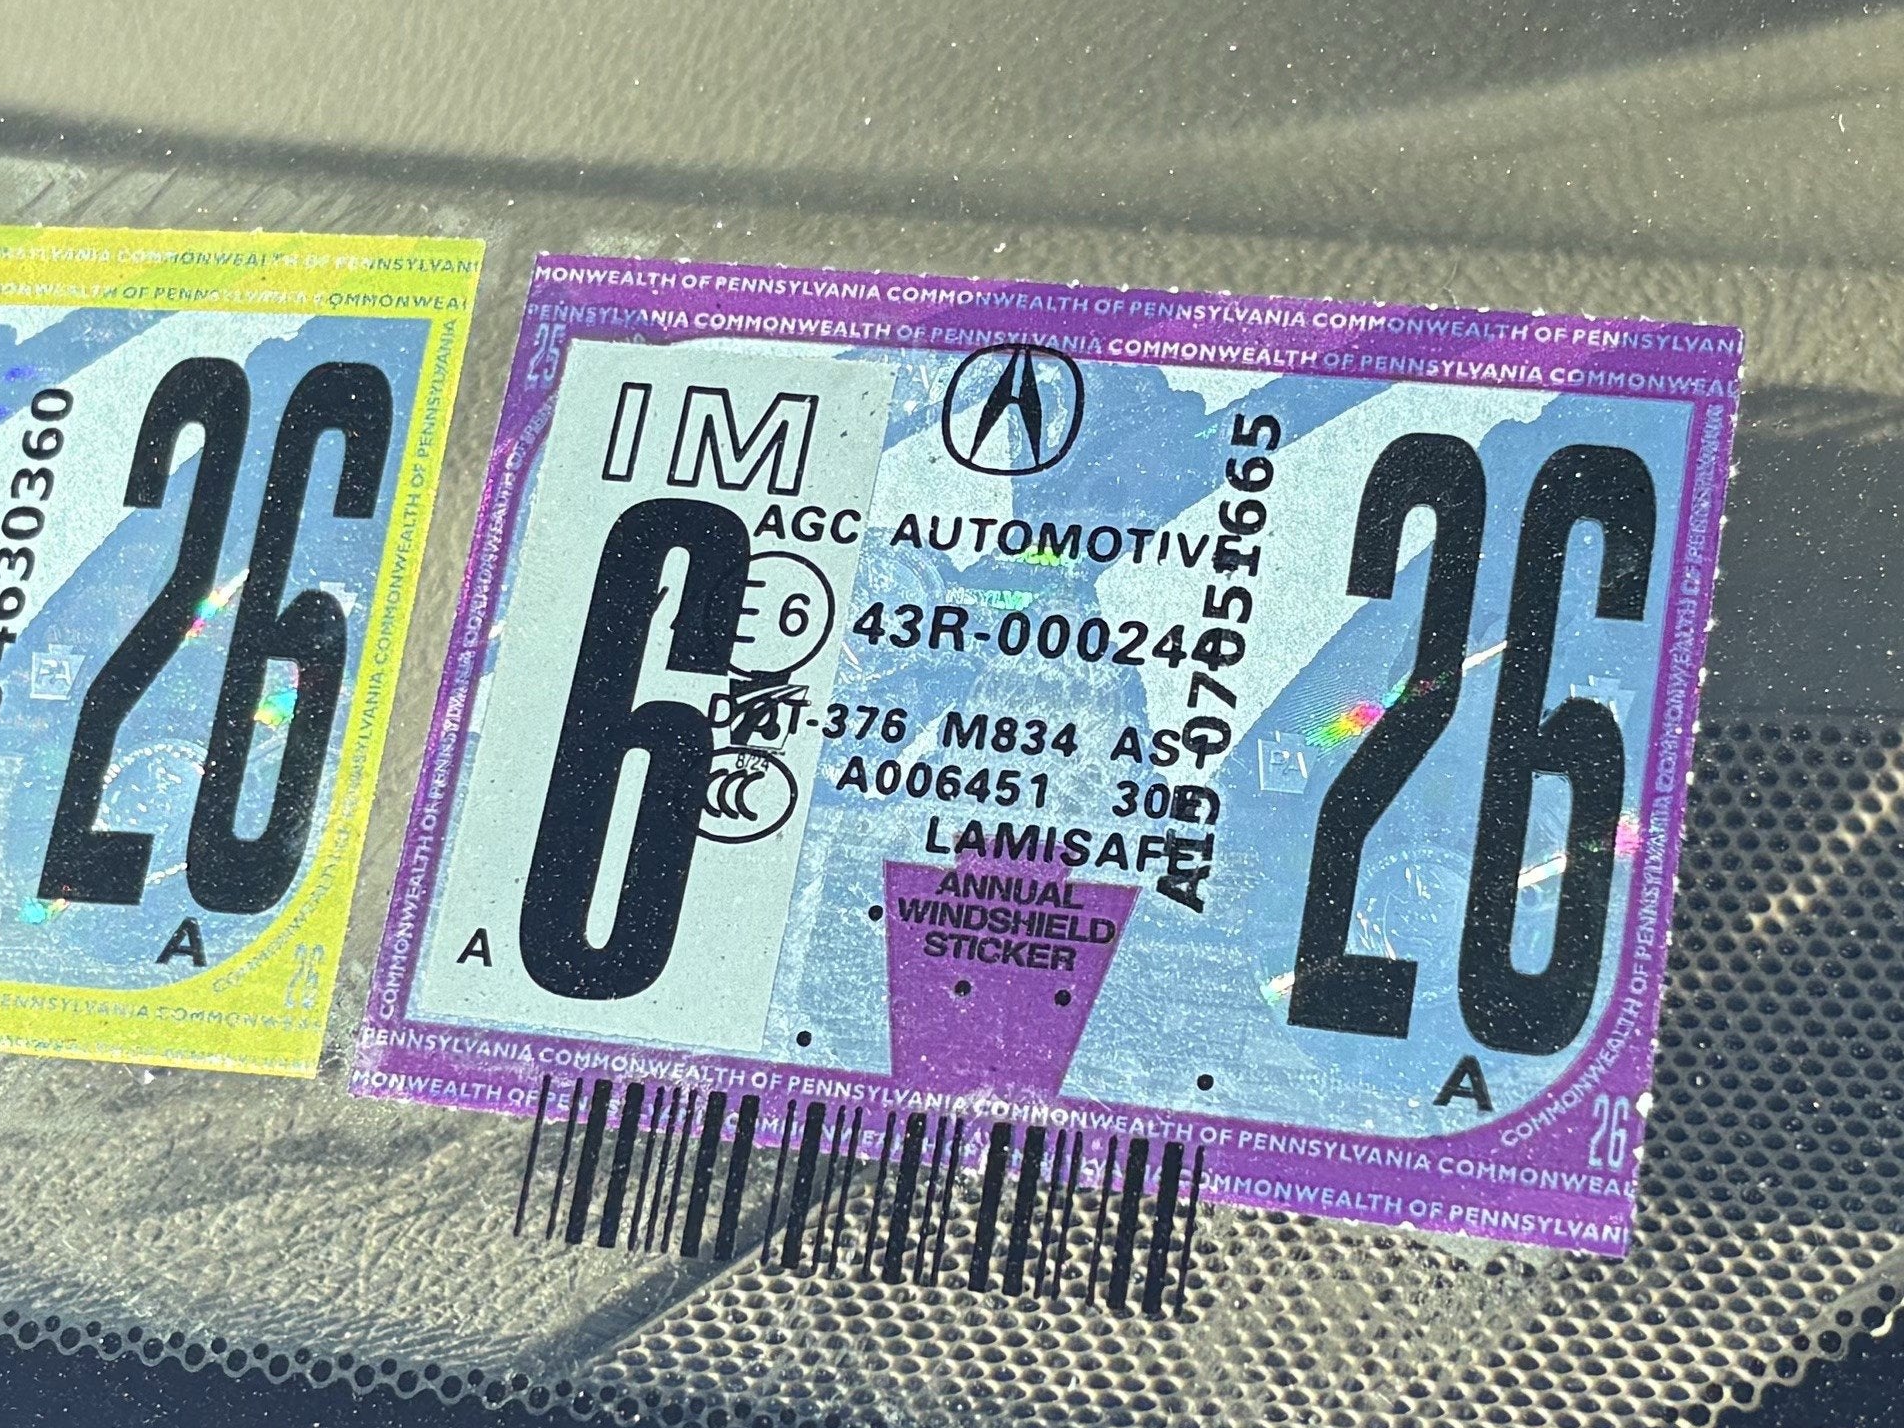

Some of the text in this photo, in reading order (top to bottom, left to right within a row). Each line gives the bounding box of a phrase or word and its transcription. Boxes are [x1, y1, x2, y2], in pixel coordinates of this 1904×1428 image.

[122, 286, 149, 301] OF
[535, 265, 676, 290] MONWEALTH
[681, 273, 710, 291] OF
[715, 274, 881, 304] PENNSYLVANIA
[886, 285, 1089, 314] COMMONWEALTH
[1095, 297, 1124, 316] OF
[1129, 299, 1305, 329] PENNSYLVANIA
[1311, 312, 1528, 341] COMMONWEALTH
[1534, 325, 1568, 344] OF
[525, 301, 1741, 399] PENNSYLVANIA COMMONWEALTH OF PENNSYLVANIA COMMONWEALTH OF PENNSYLVANIA COMMONWEAL
[603, 381, 820, 497] IM
[753, 504, 862, 545] AGC
[37, 356, 394, 915] 26
[518, 497, 752, 1001] 6
[941, 709, 1080, 760] M834
[1286, 431, 1658, 1057] 26
[835, 753, 1050, 811] A006451
[897, 895, 1117, 945] WINDSHIELD
[936, 870, 1085, 911] ANNUAL
[155, 917, 207, 968] A
[379, 835, 435, 1021] COMMONWEALTH
[456, 927, 493, 968] A
[923, 930, 1077, 973] STICKER
[1432, 1053, 1494, 1113] A
[1500, 997, 1643, 1150] COMMONWEALTH
[1628, 972, 1652, 996] OF
[361, 1026, 1636, 1199] PENNSYLVANIA COMMONWEALTH OF PENNSYLVANIA COMMONWEALTH OF PENNSYLVANIA COMMONWEAL
[508, 1086, 539, 1108] OF
[1588, 1092, 1631, 1171] 26
[1409, 1198, 1444, 1221] OF
